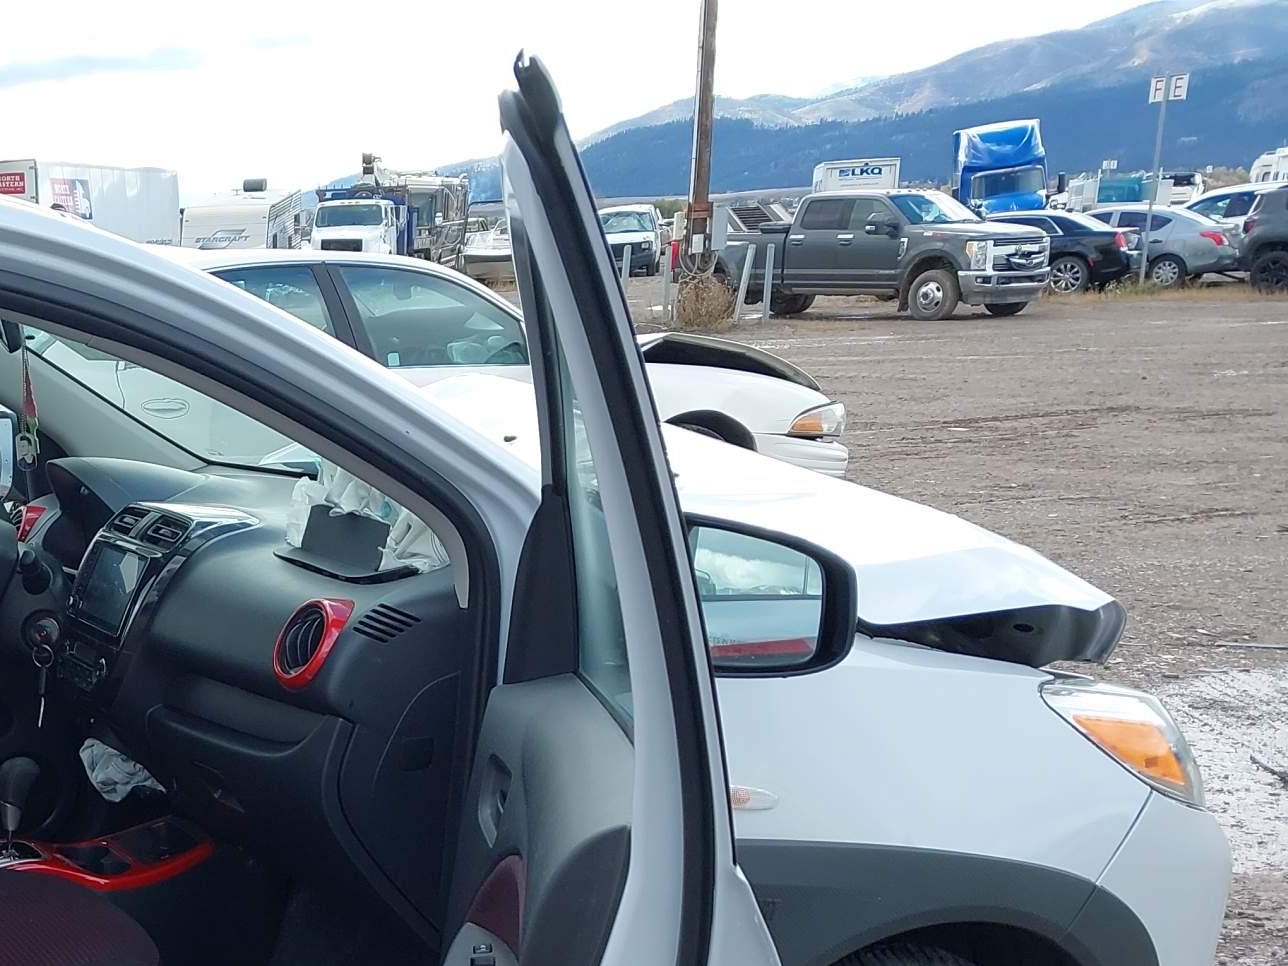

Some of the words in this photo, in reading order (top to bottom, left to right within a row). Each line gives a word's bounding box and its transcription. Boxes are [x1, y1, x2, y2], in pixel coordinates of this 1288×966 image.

[1153, 79, 1164, 100] F
[1173, 77, 1185, 98] E
[195, 235, 250, 243] STARCRAFT
